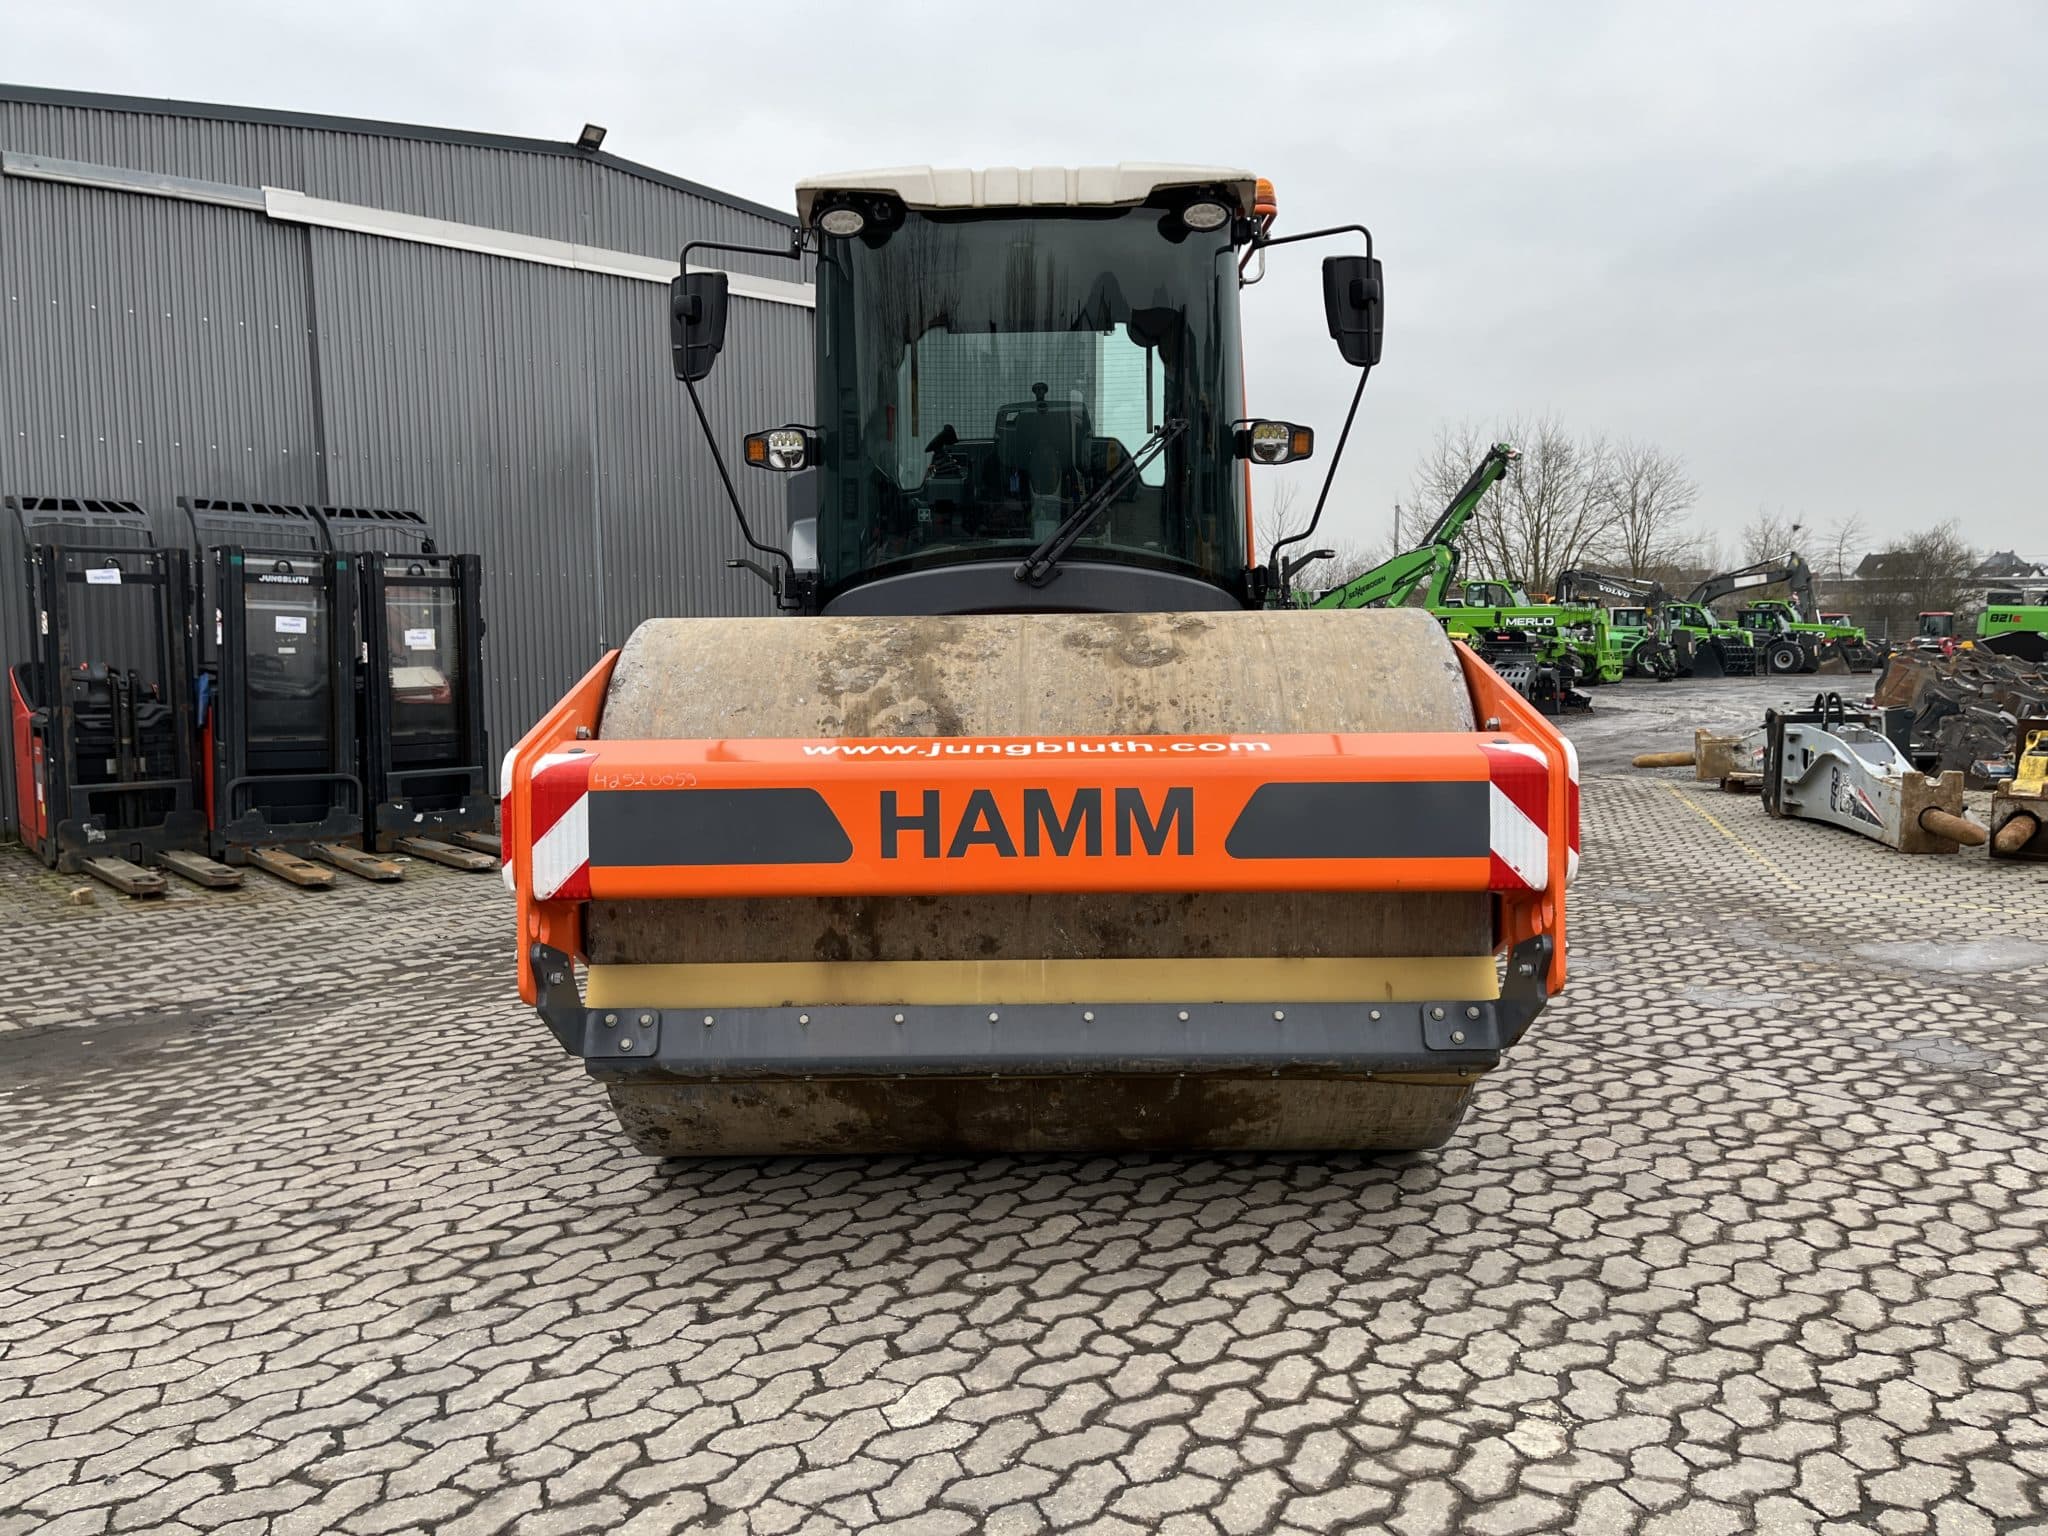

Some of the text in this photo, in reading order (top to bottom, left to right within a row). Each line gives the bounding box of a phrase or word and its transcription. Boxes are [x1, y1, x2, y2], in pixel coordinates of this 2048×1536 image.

[1599, 584, 1630, 598] VOLVO
[1505, 617, 1555, 626] MERLO
[802, 741, 1271, 757] www.jungbluth.com
[880, 787, 1194, 859] HAMM
